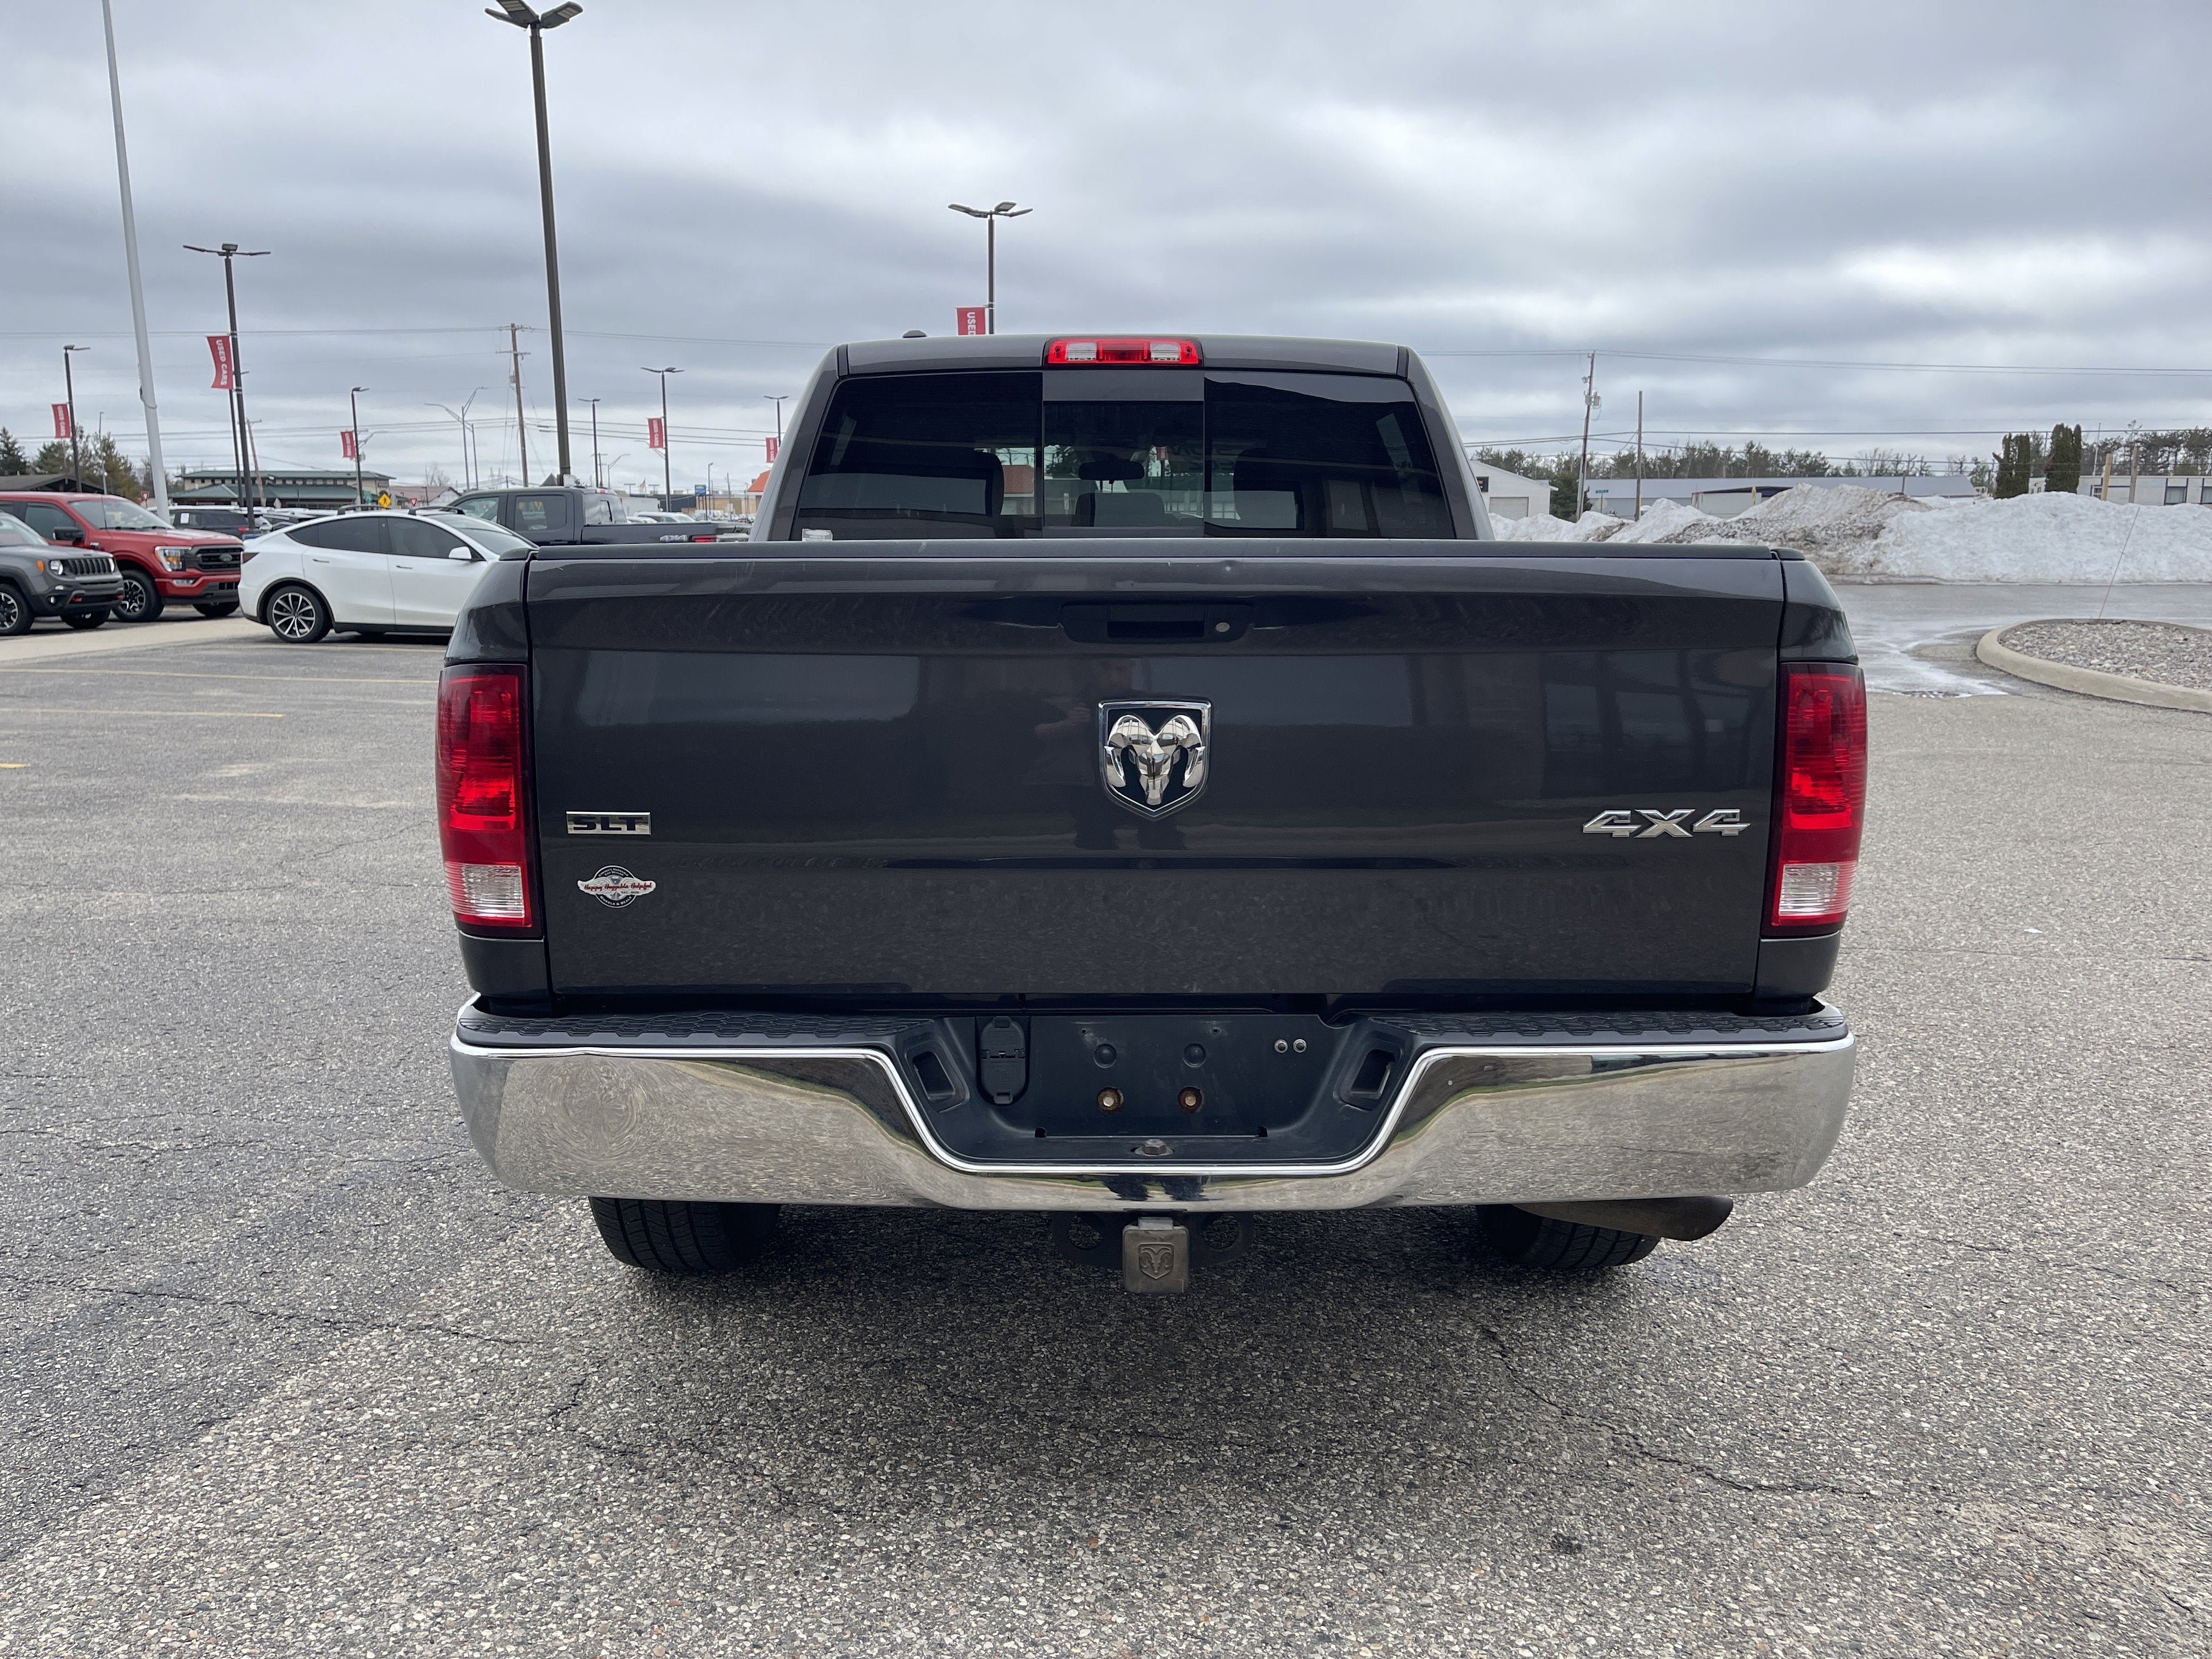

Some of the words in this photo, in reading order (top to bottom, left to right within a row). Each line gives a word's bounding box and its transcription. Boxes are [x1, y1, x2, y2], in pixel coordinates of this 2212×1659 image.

[216, 339, 226, 362] USED
[573, 816, 643, 831] SLT
[1583, 809, 1751, 838] 4X4
[631, 882, 652, 890] Helpful
